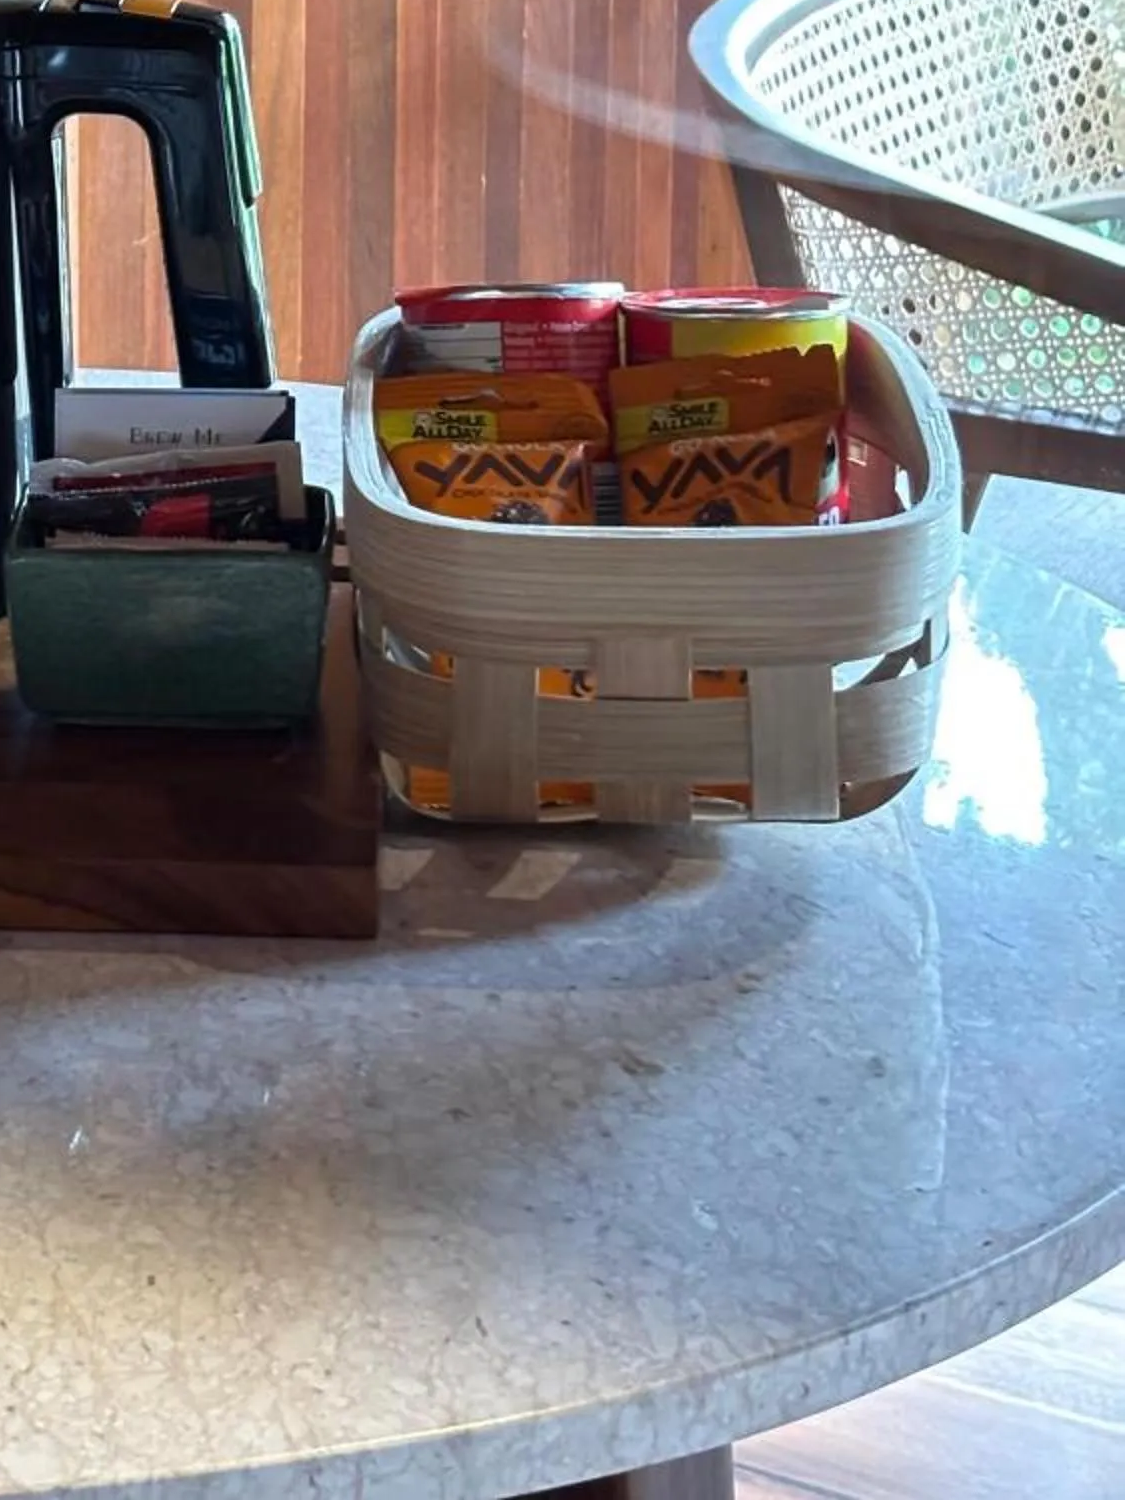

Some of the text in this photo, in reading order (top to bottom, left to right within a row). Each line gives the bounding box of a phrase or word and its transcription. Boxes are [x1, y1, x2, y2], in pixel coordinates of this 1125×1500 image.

[436, 411, 487, 426] SMILE
[668, 401, 719, 419] SMILE
[630, 440, 793, 515] YAVA
